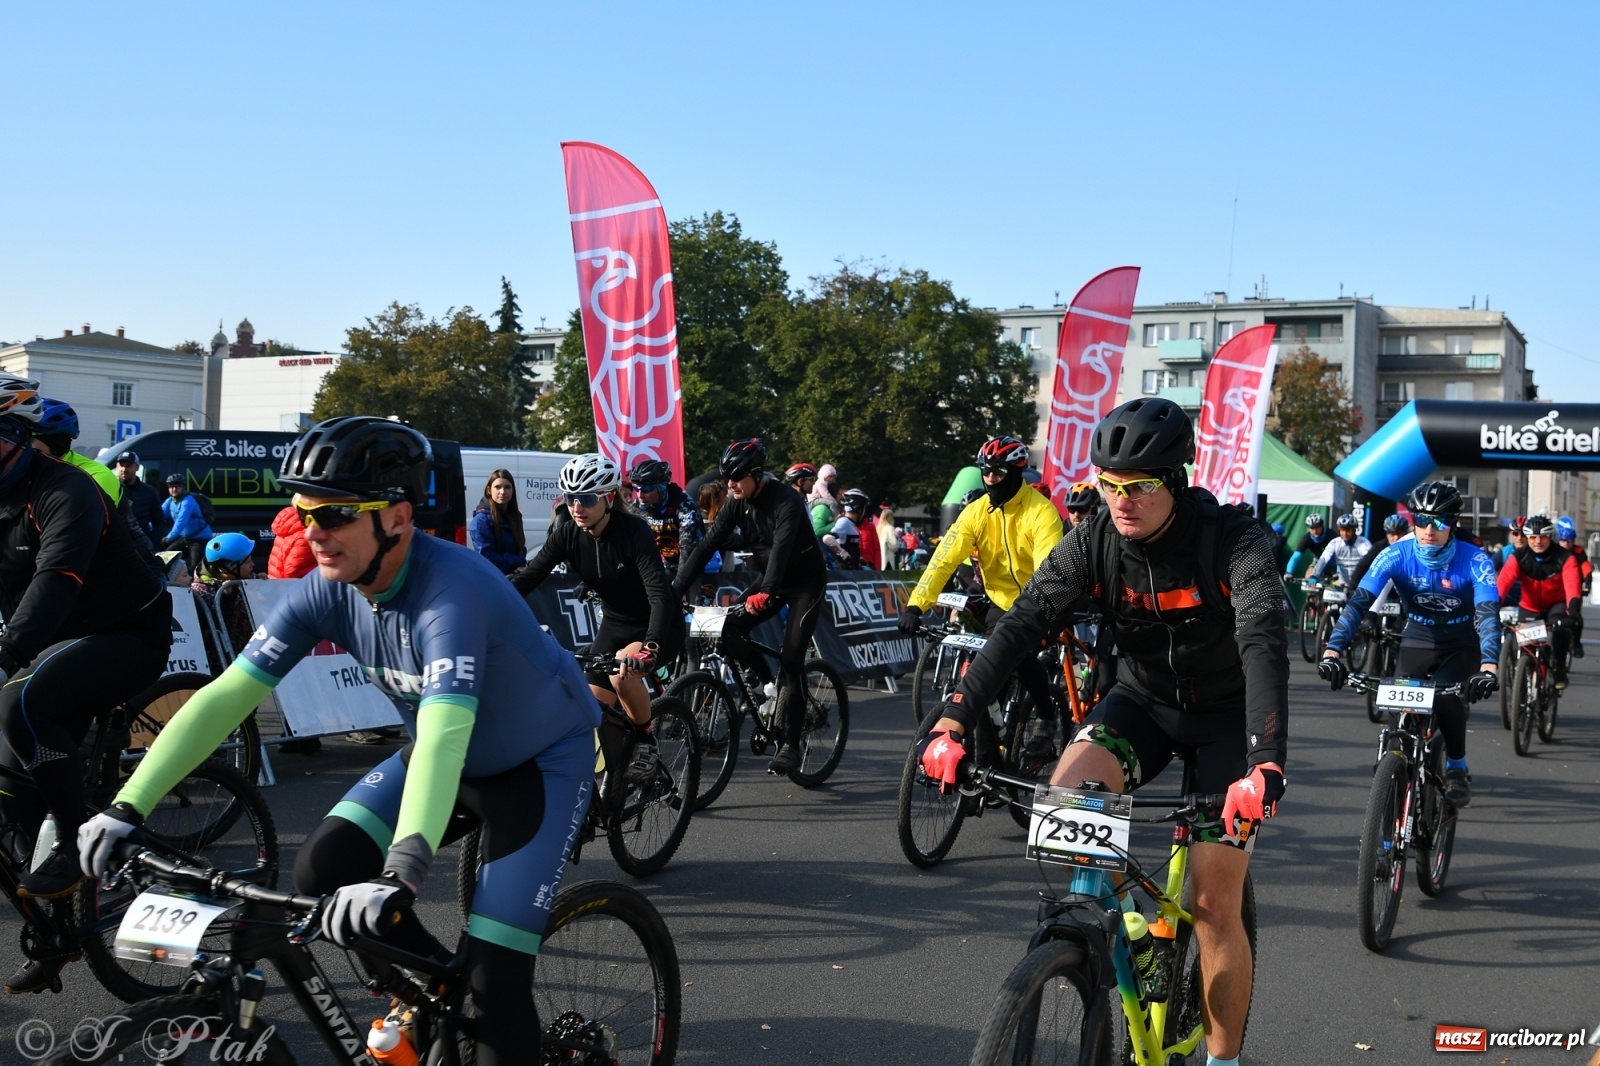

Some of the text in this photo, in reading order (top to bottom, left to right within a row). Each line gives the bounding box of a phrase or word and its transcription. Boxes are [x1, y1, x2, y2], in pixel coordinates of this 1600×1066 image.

[225, 439, 268, 458] bike
[1480, 423, 1539, 452] bike
[942, 593, 963, 604] 2764
[952, 635, 984, 648] 3293
[1388, 689, 1425, 703] 3158
[1046, 818, 1113, 849] 2392
[533, 884, 550, 908] HPE
[133, 904, 199, 935] 2139
[303, 975, 361, 1056] SANTA
